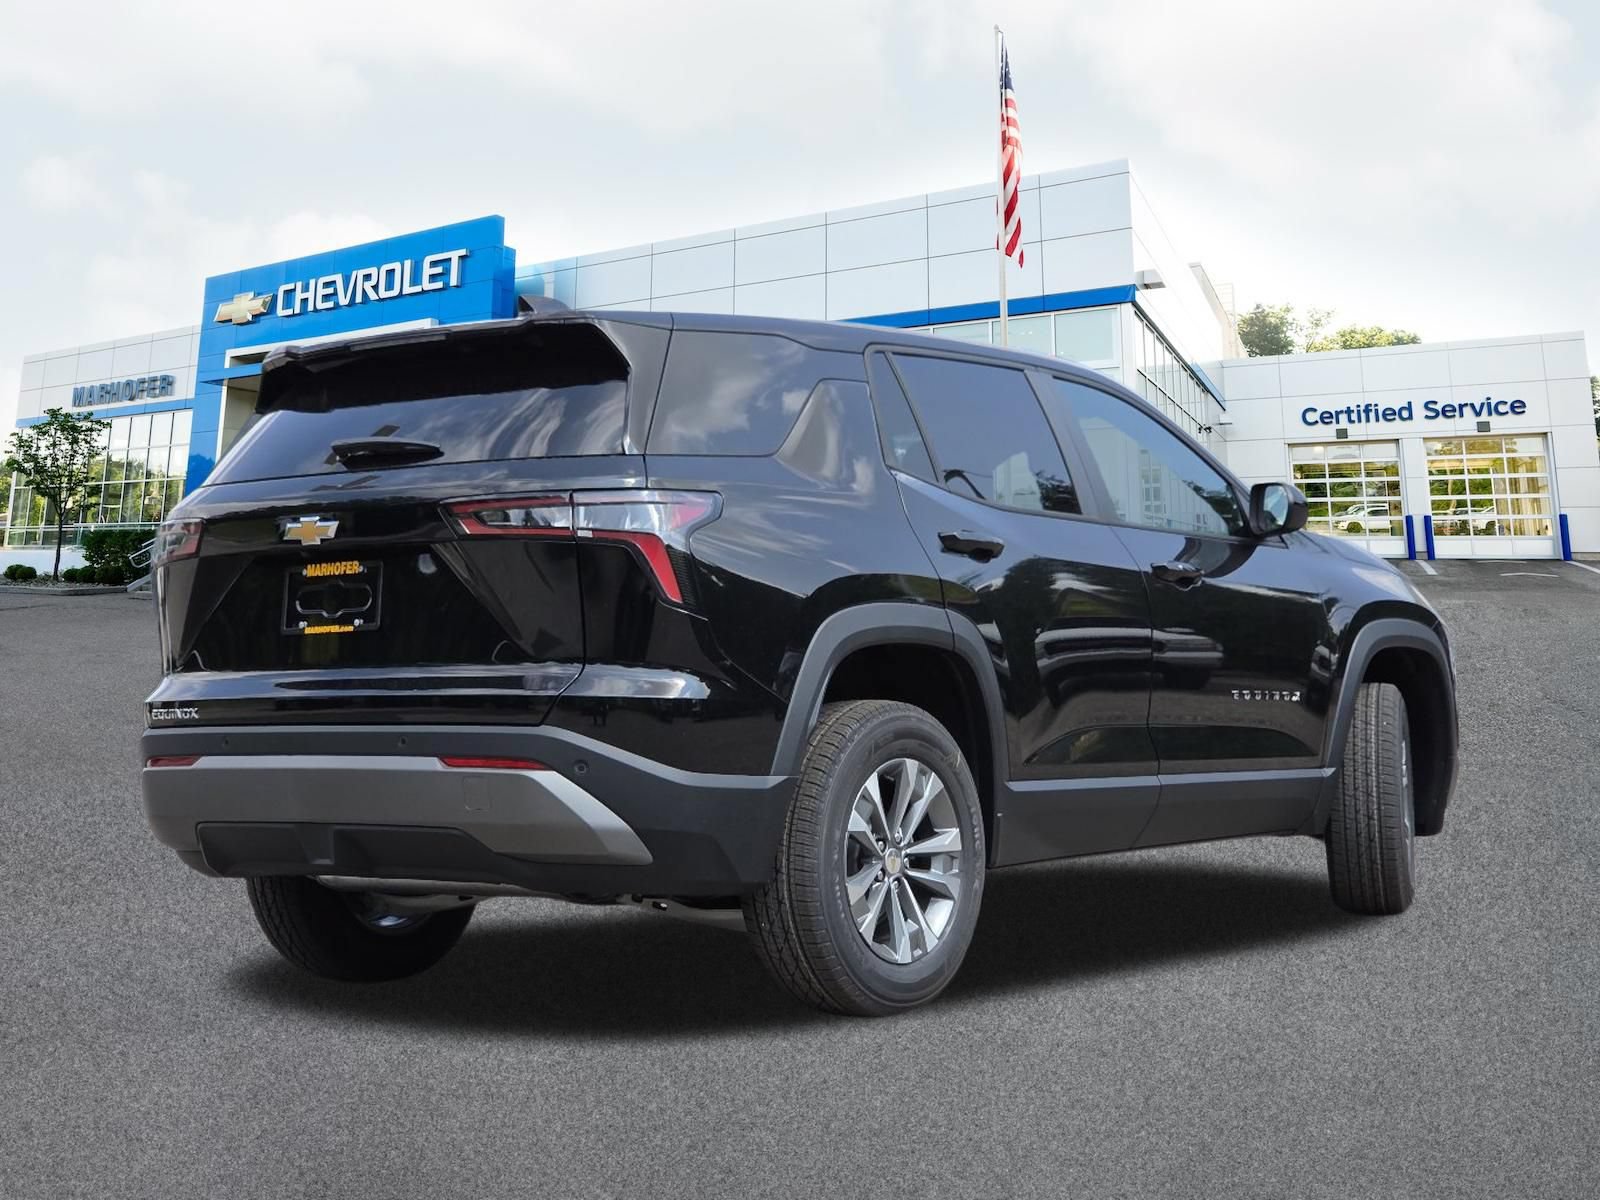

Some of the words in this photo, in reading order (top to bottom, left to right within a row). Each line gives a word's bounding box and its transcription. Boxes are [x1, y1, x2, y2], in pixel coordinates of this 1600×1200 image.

[276, 248, 468, 318] CHEVROLET
[72, 374, 174, 407] MARHOFER
[1301, 401, 1413, 426] Certified
[1424, 397, 1527, 420] Service
[306, 561, 361, 577] MARHOFER
